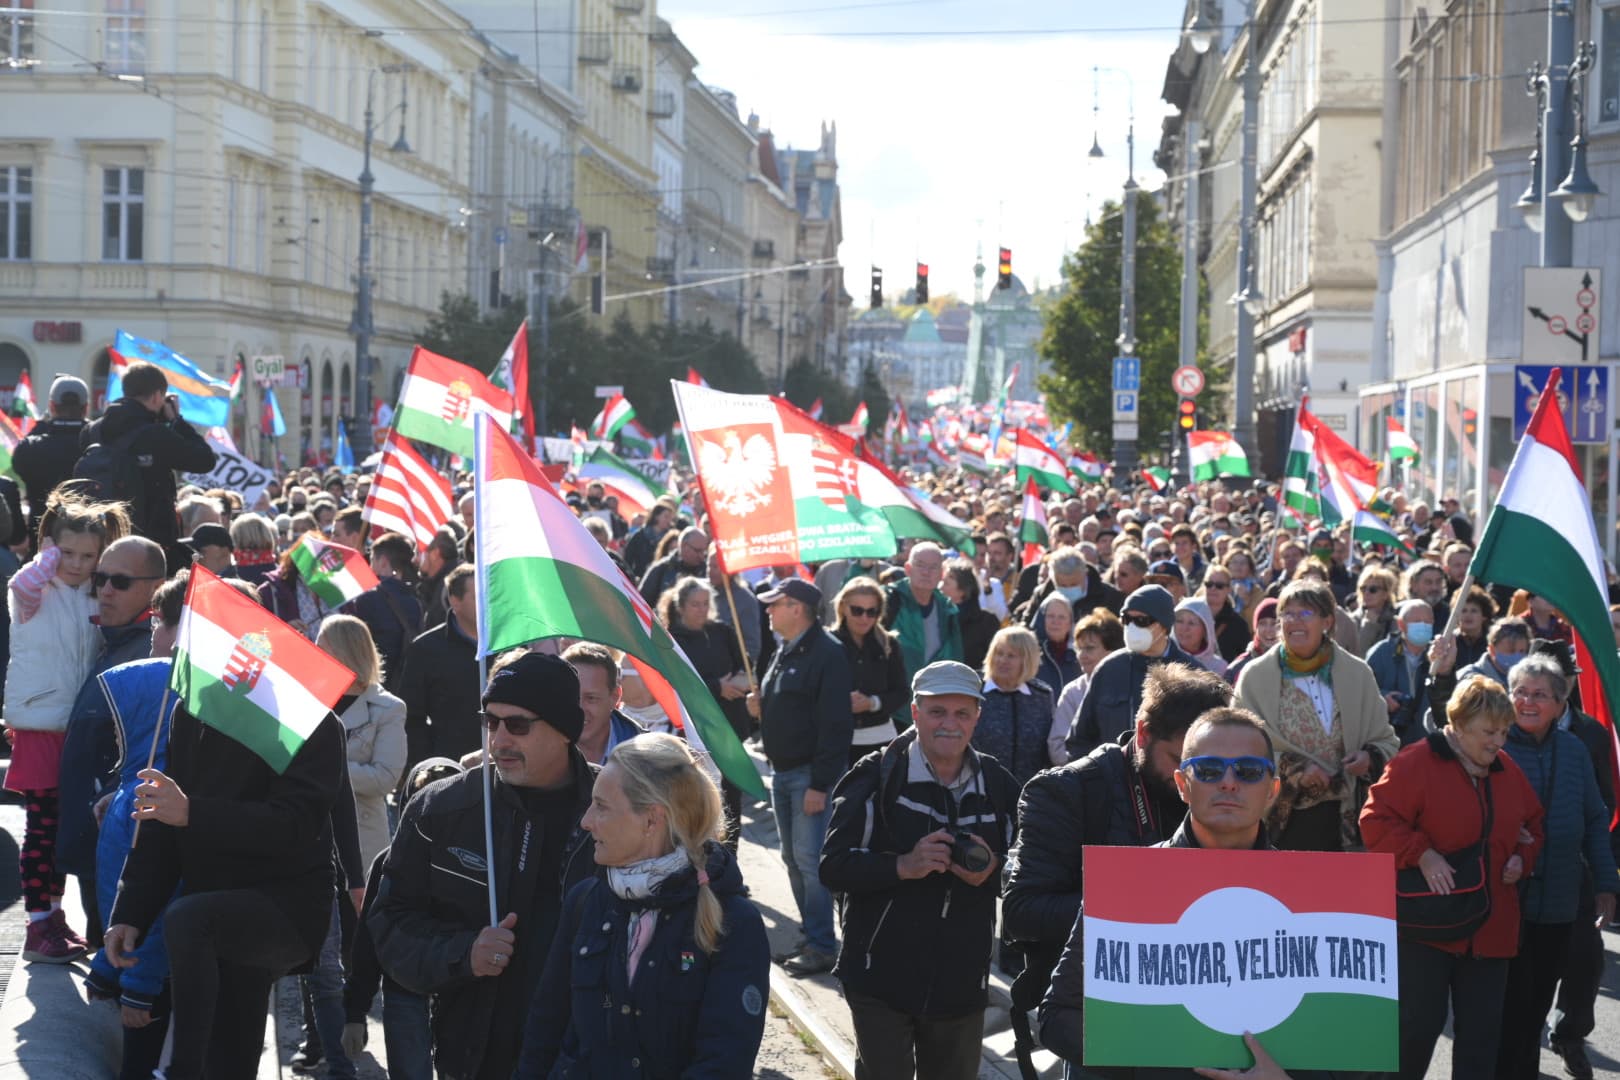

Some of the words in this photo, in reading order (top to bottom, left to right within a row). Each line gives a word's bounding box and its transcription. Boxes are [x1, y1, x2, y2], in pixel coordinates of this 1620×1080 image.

[212, 452, 266, 491] TOP
[637, 462, 668, 478] TOP
[1134, 784, 1148, 825] Canon
[1094, 937, 1130, 984] AKI
[1138, 941, 1232, 988] MAGYAR,
[1234, 929, 1319, 982] VELÜNK
[1325, 935, 1386, 985] TART!
